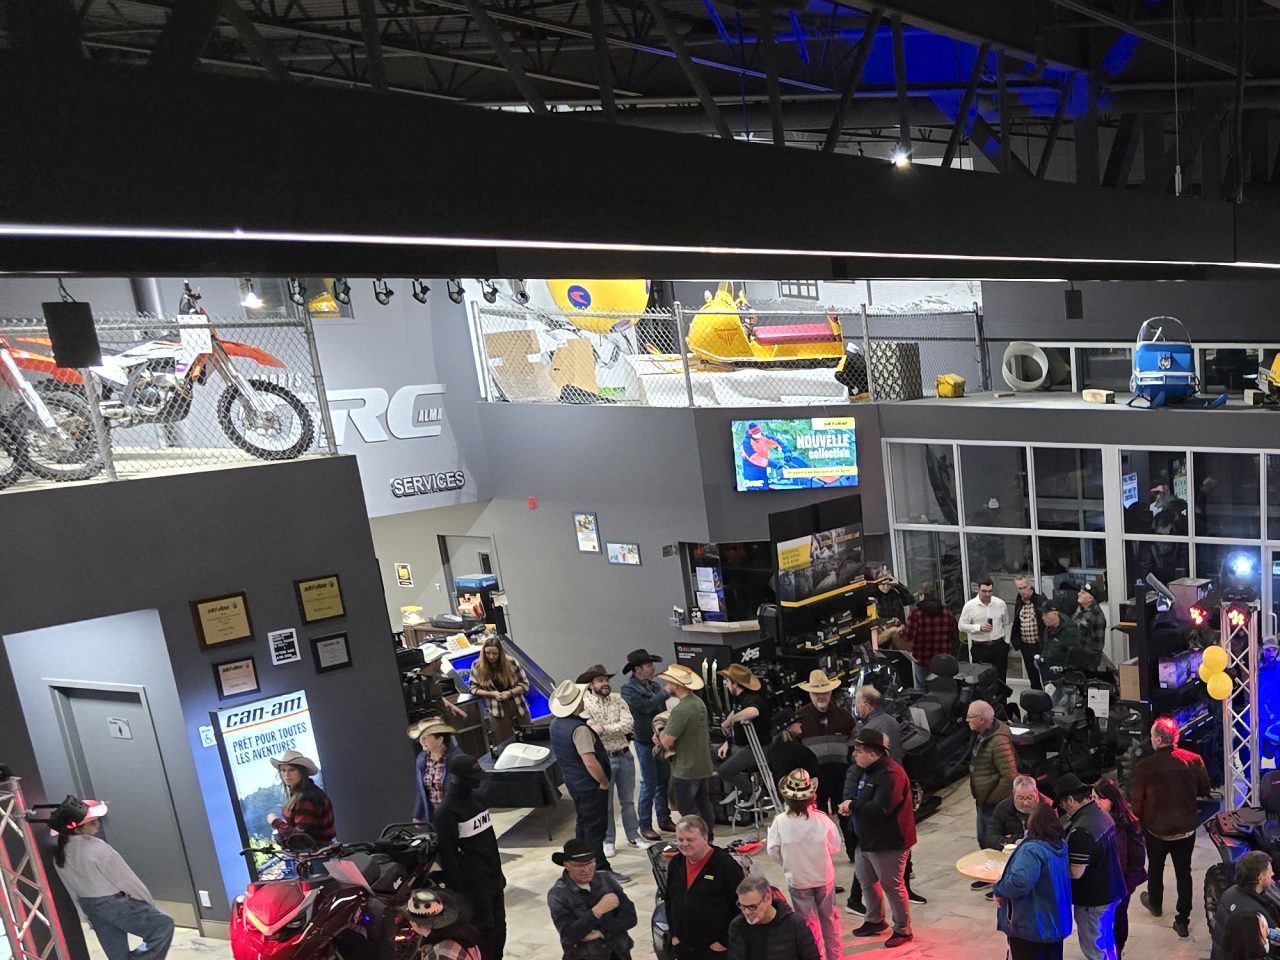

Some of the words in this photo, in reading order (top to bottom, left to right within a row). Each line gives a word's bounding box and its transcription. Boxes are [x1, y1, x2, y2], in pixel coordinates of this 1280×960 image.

[416, 407, 443, 423] ALMA
[796, 433, 850, 449] NOUVELLE
[808, 447, 851, 460] collection
[391, 470, 465, 497] SERVICES
[225, 696, 302, 729] can-am
[232, 735, 253, 753] PRÊT
[254, 730, 277, 747] POUR
[278, 721, 308, 740] TOUTES
[235, 751, 251, 765] LES
[252, 738, 297, 762] AVENTURES
